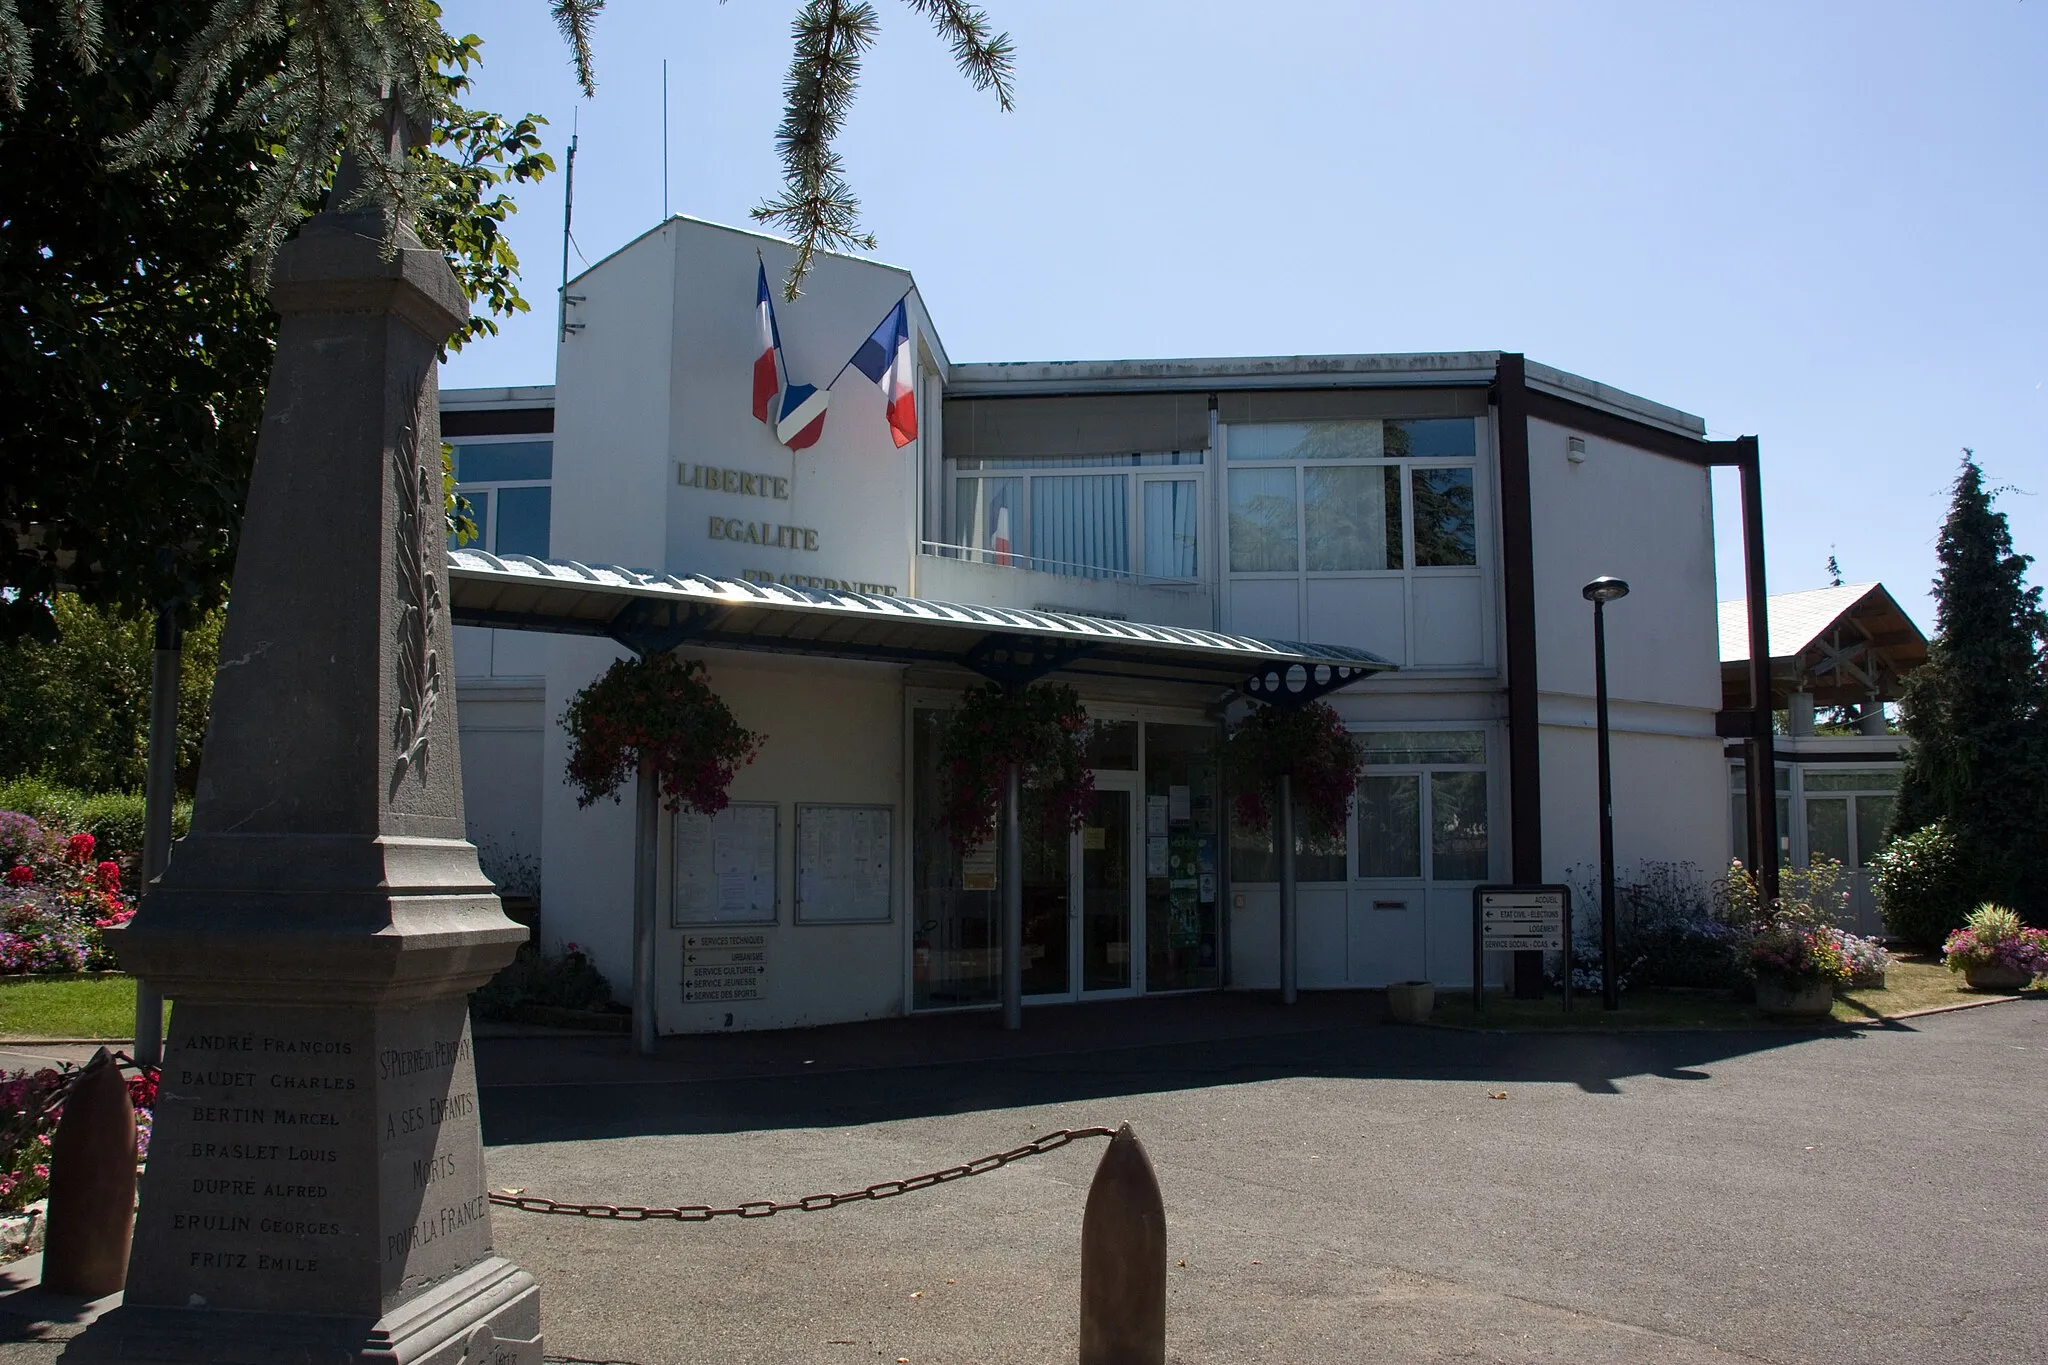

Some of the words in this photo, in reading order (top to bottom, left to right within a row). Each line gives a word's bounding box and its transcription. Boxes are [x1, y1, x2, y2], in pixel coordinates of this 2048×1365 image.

[678, 462, 789, 500] LIBERTE
[709, 515, 820, 552] EGALITE
[701, 937, 728, 946] SERVICES
[729, 936, 764, 945] TECHNIQUES
[731, 952, 764, 961] URBANISME
[693, 967, 722, 976] SERVICE
[723, 966, 756, 975] CULTUREL
[693, 979, 721, 988] SERVICE
[724, 978, 757, 987] JEUNESSE
[694, 991, 720, 1000] SERVICE
[720, 991, 732, 999] DES
[734, 990, 757, 998] SPORTS
[185, 1032, 252, 1051] ANDRÉ
[263, 1037, 353, 1056] FRANÇOIS
[182, 1071, 256, 1087] BAUDET
[270, 1074, 356, 1090] CHARLES
[193, 1107, 264, 1124] BERTIN
[274, 1110, 340, 1126] MARCEL
[386, 1112, 396, 1140] A
[401, 1106, 425, 1135] SES
[430, 1092, 473, 1126] ENFANTS
[191, 1143, 279, 1160] BRASLET
[288, 1146, 337, 1162] LOUIS
[413, 1153, 455, 1190] MORTS
[193, 1176, 255, 1195] DUPRÉ
[263, 1184, 328, 1198] ALFRED
[174, 1214, 250, 1232] ERULIN
[260, 1218, 340, 1235] GEORGES
[388, 1226, 420, 1261] POUR
[423, 1220, 438, 1244] LA
[440, 1195, 485, 1236] FRANCE
[190, 1252, 248, 1268] FRITZ
[258, 1255, 318, 1272] EMILE
